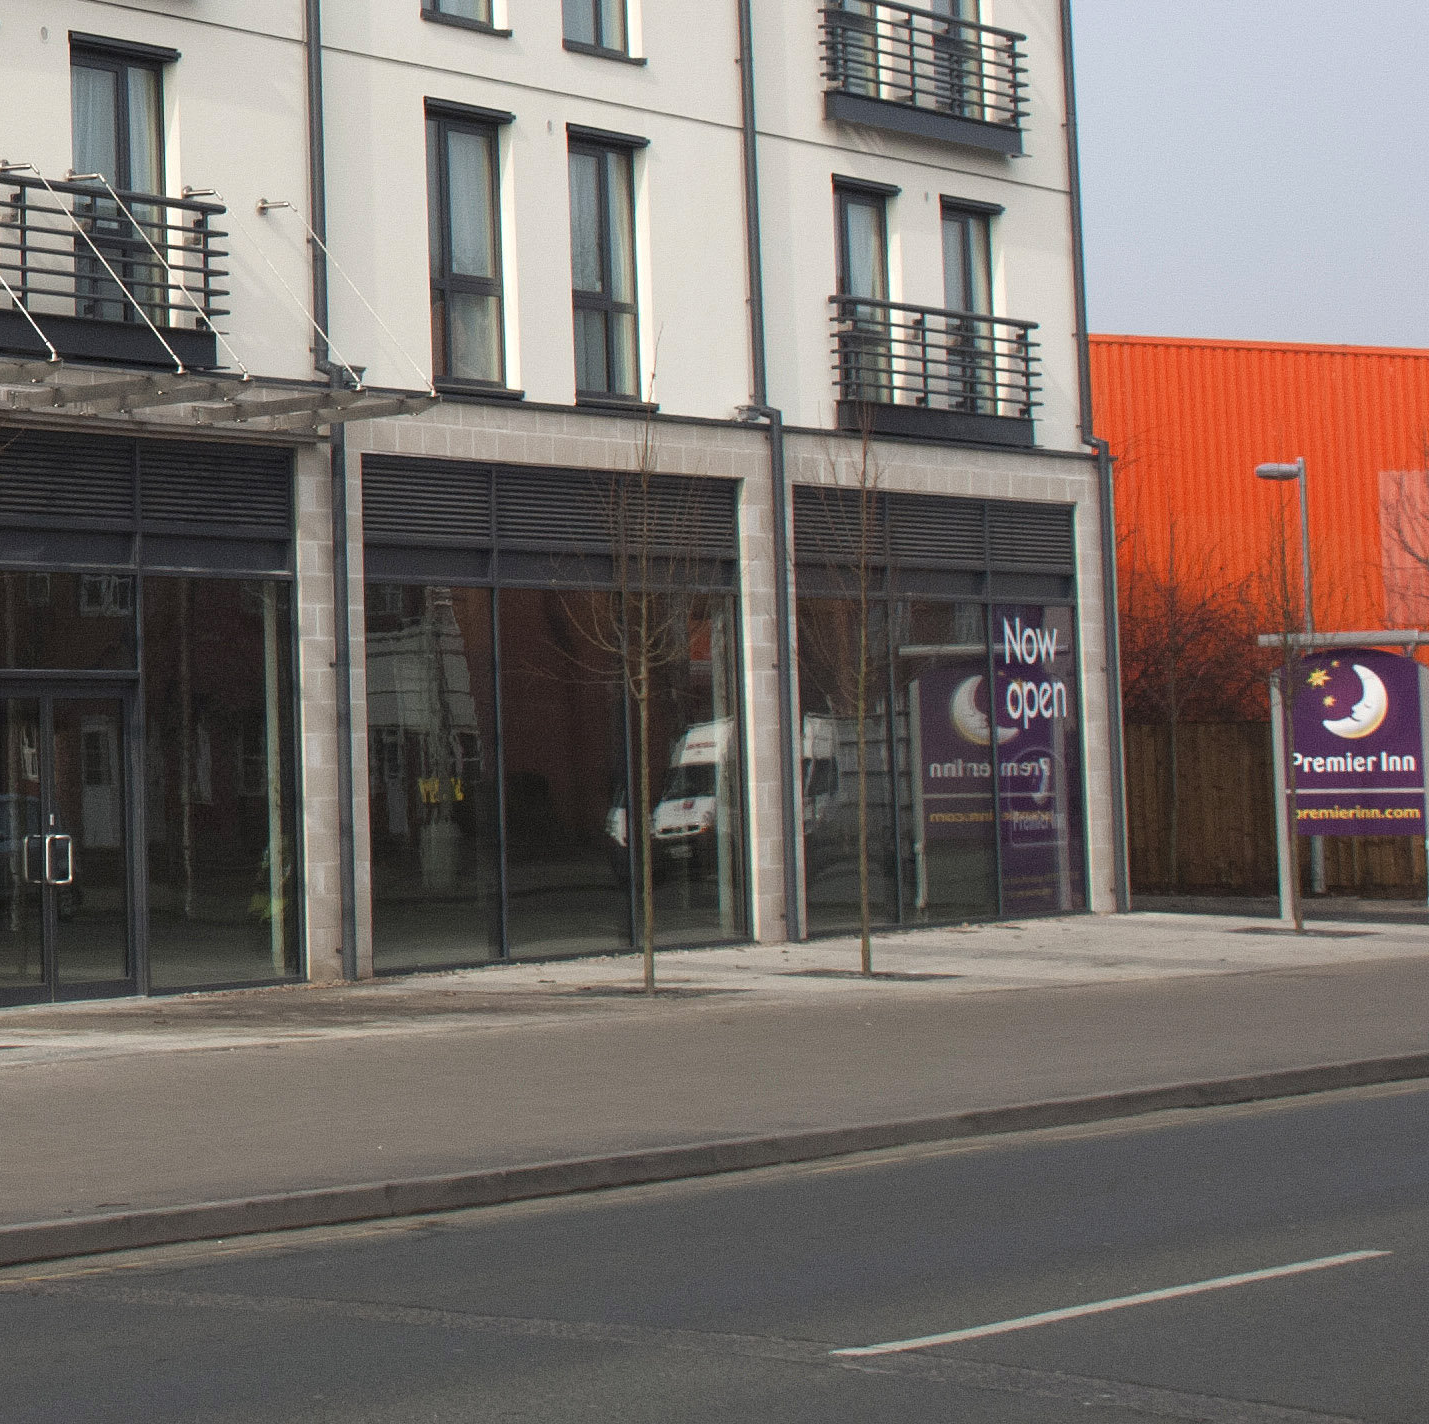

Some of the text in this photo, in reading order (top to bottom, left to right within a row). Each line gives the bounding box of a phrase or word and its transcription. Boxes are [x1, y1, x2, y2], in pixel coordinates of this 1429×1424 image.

[1003, 616, 1058, 664] Now
[1006, 681, 1067, 730] open
[1292, 751, 1417, 773] Premier Inn
